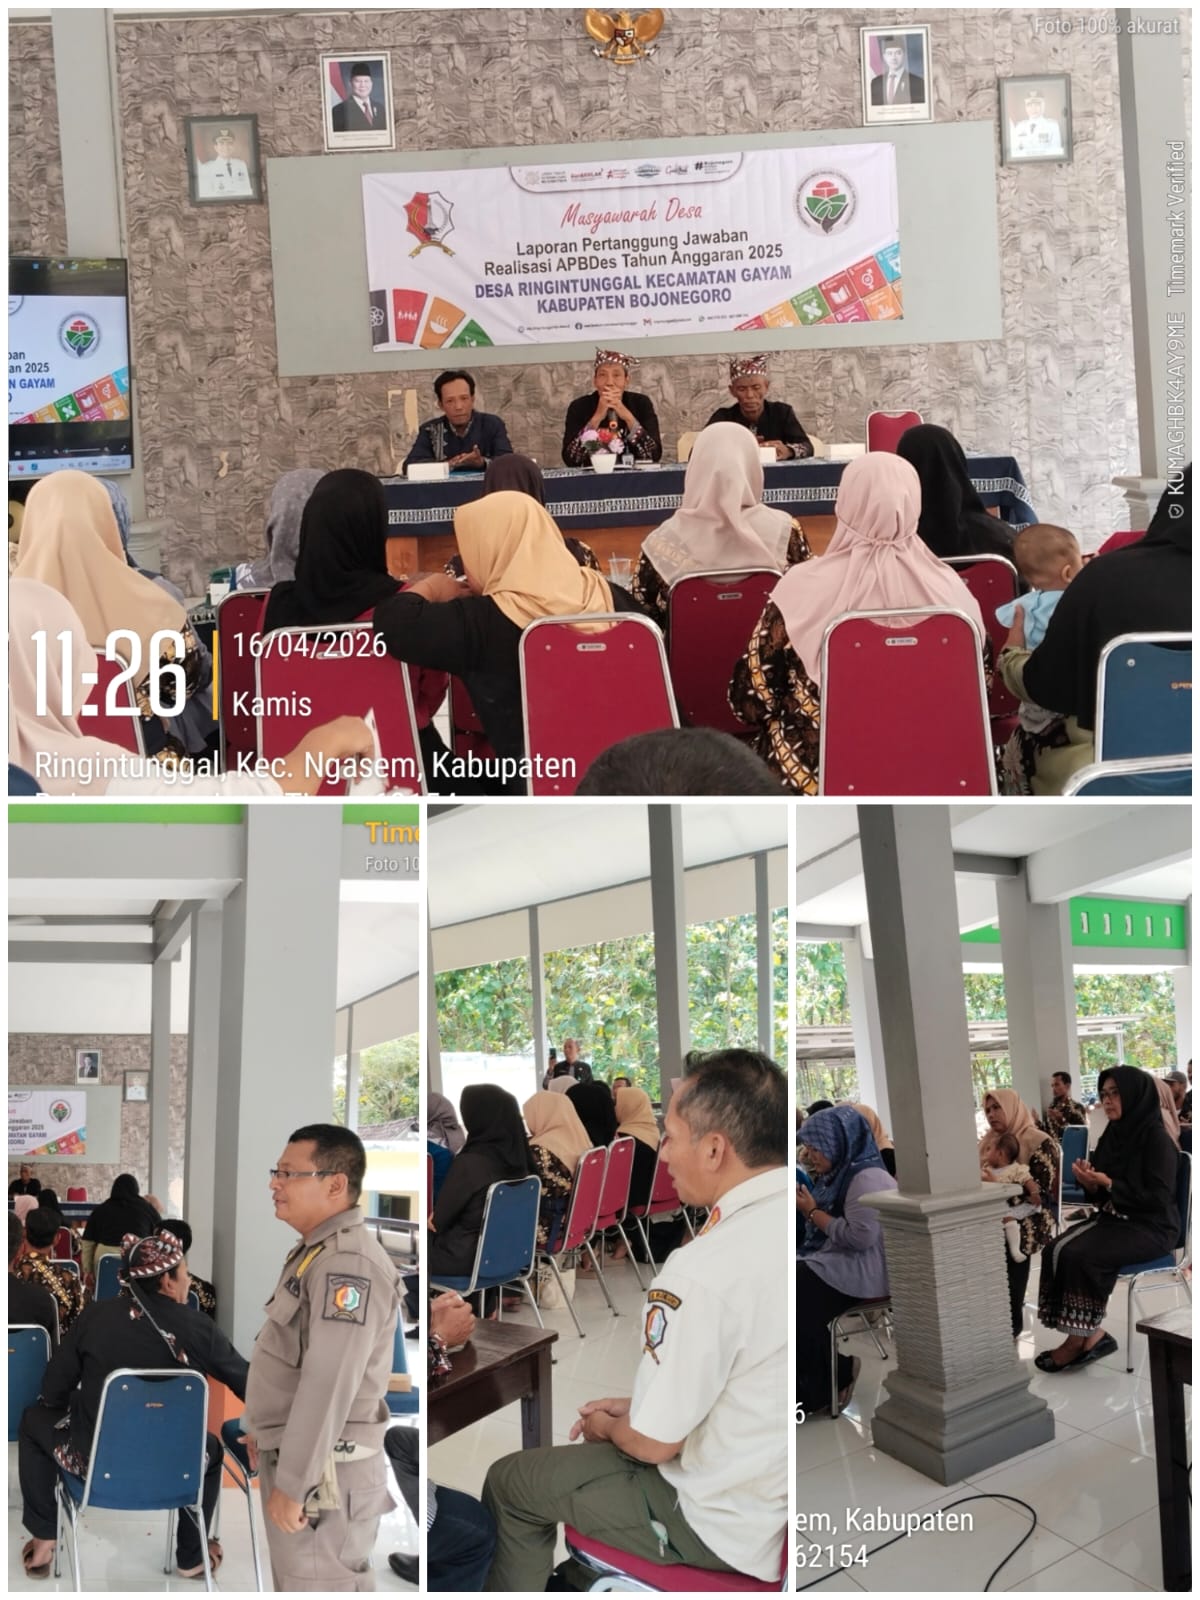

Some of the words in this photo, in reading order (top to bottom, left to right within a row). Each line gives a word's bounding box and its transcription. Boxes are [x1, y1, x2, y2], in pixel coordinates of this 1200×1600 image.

[560, 200, 657, 234] Musyawarah
[665, 197, 703, 222] Desa
[516, 240, 578, 257] Laporan
[582, 234, 678, 252] Pertanggung
[682, 229, 749, 246] Jawaban
[484, 259, 552, 276] Realisasi
[556, 256, 617, 272] APBDes
[621, 252, 667, 268] Tahun
[671, 249, 744, 267] Anggaran
[748, 243, 784, 260] 2025
[475, 283, 514, 299] DESA
[518, 275, 642, 297] RINGINTUNGGAL
[645, 269, 736, 290] KECAMATAN
[741, 265, 792, 283] GAYAM
[537, 295, 625, 314] KABUPATEN
[630, 287, 732, 309] BOJONEGORO
[25, 362, 50, 373] 2025
[19, 378, 55, 389] GAYAM
